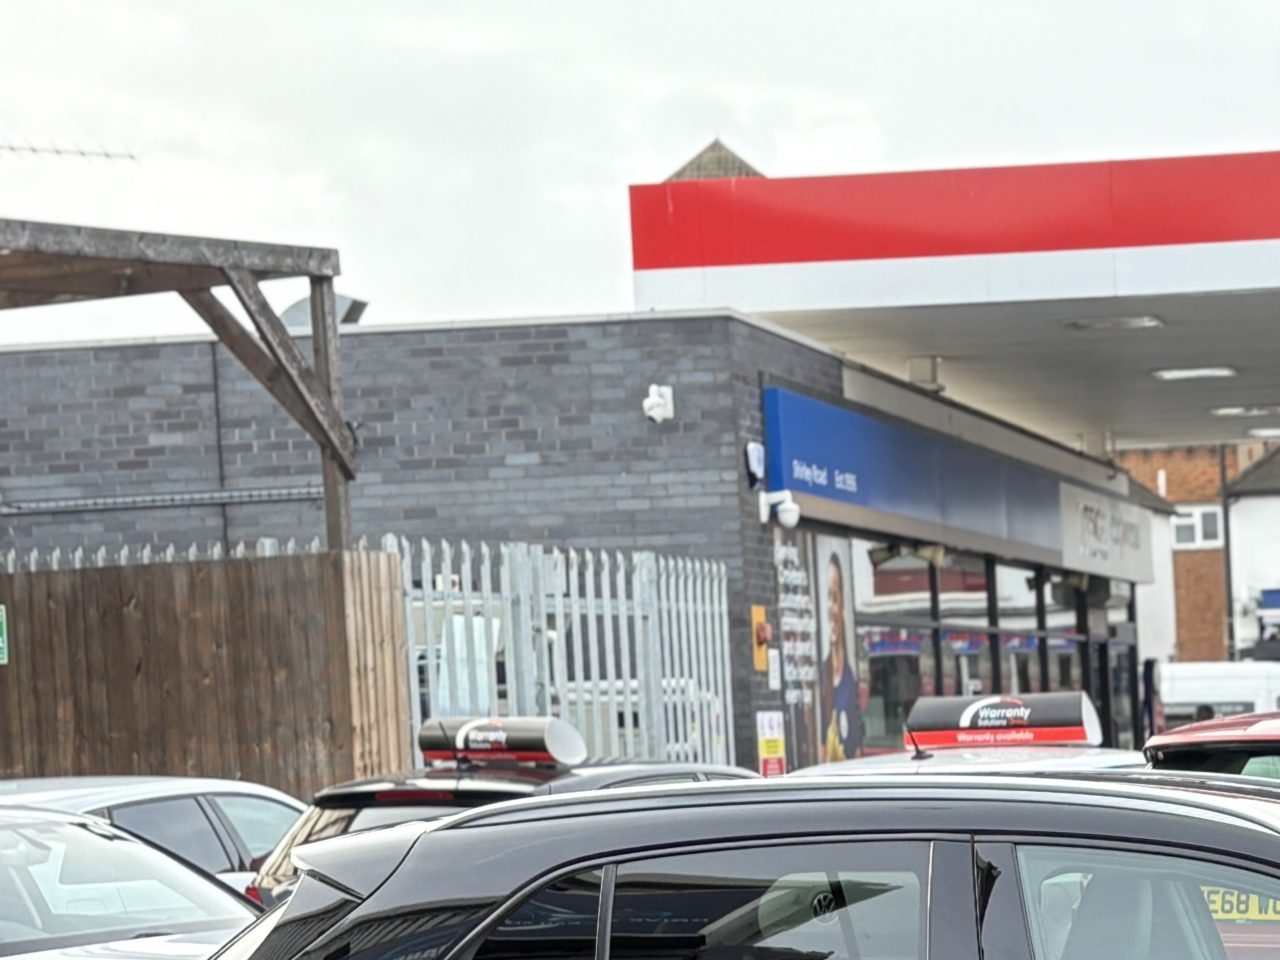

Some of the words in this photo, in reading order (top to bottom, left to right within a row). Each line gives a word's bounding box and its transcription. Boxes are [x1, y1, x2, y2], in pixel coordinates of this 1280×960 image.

[978, 706, 1031, 720] Warranty
[957, 733, 995, 743] Warranty
[996, 731, 1034, 741] available
[1203, 888, 1251, 915] E68
